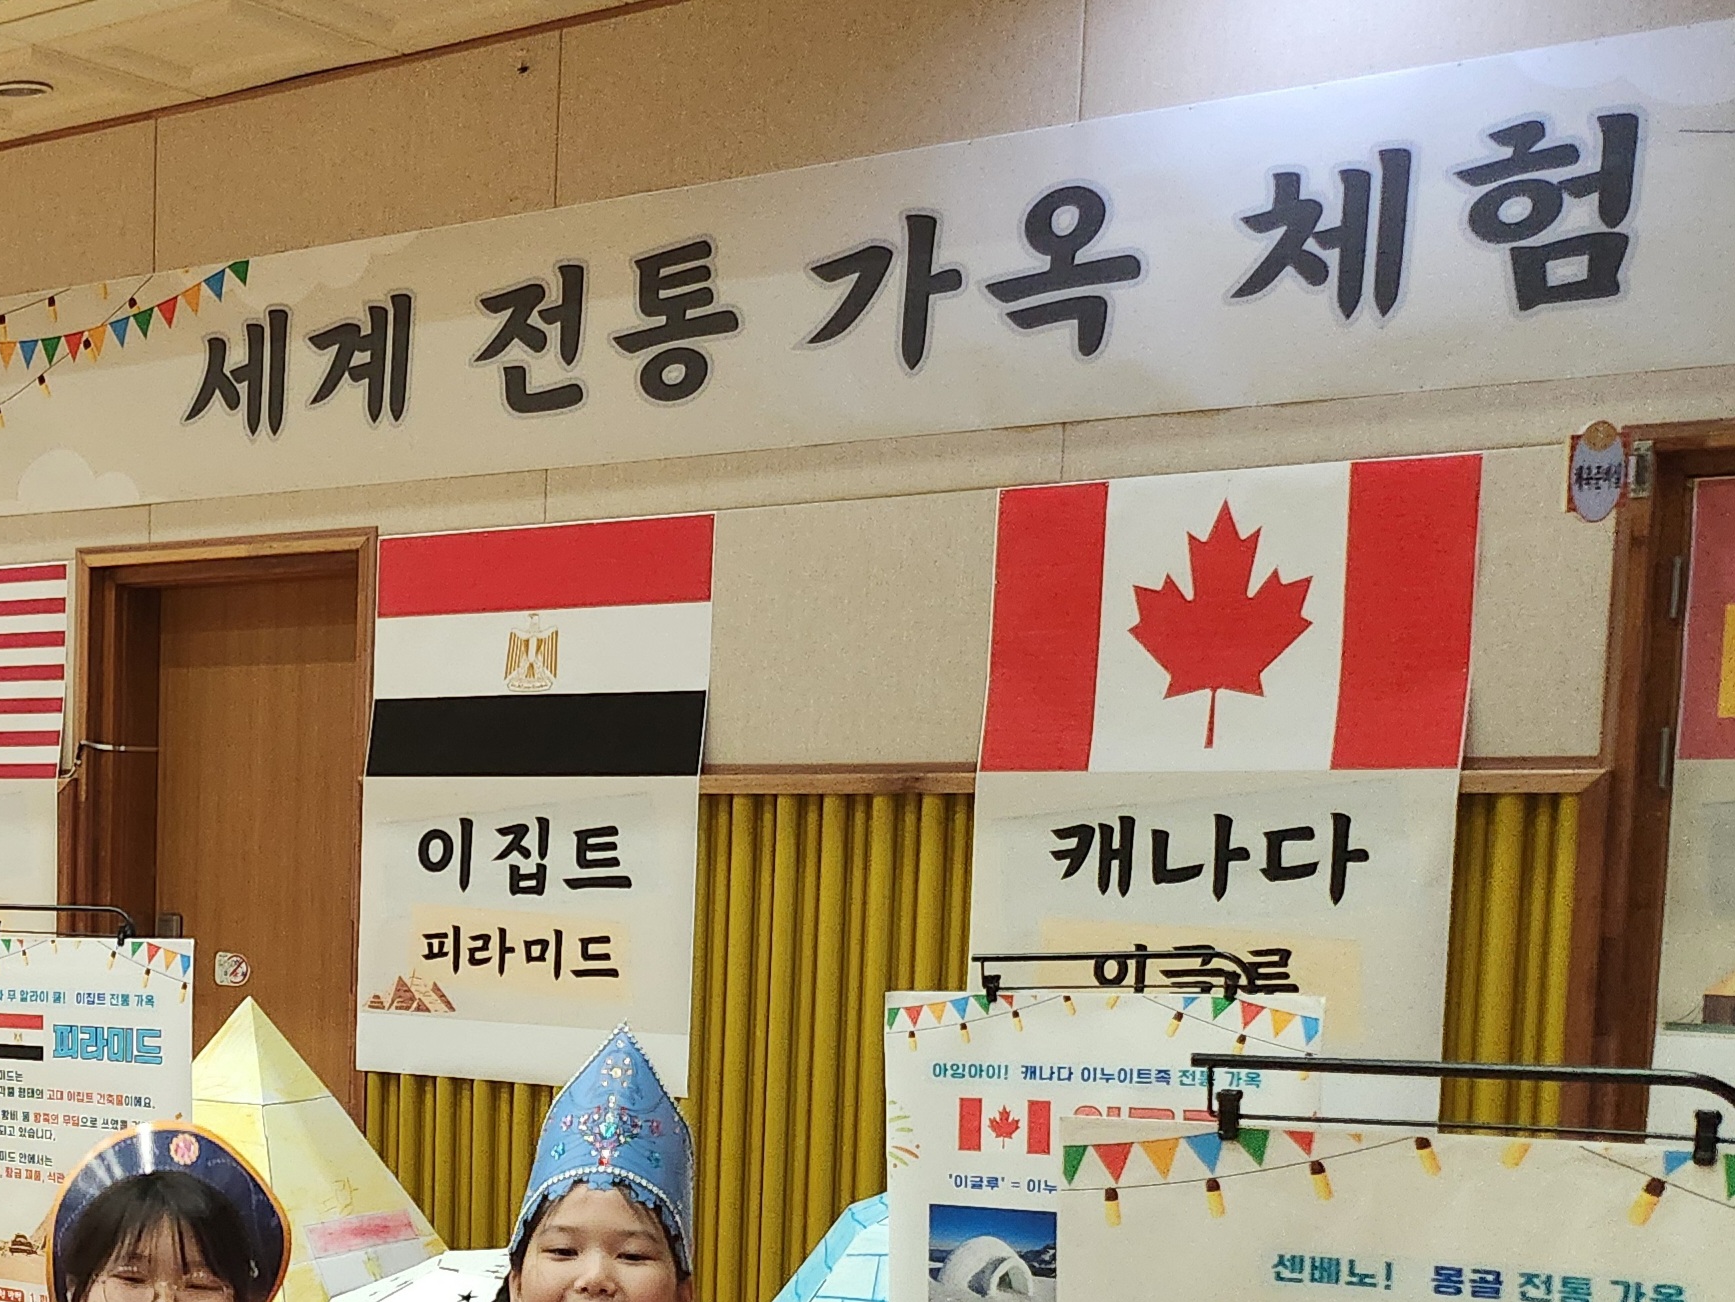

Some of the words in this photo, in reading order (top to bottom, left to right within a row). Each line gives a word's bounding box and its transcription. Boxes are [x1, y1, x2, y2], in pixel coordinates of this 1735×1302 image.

[189, 293, 410, 437] 세계
[478, 234, 742, 415] 전통
[802, 185, 1142, 370] 가옥
[1231, 111, 1641, 321] 체험
[418, 816, 633, 896] 이집트
[1049, 813, 1370, 906] 캐나다
[420, 925, 620, 981] 피라미드
[20, 990, 49, 1003] 알라이
[75, 992, 106, 1006] 이집트
[109, 993, 130, 1007] 전통
[134, 994, 155, 1008] 가옥
[53, 1023, 163, 1065] 피라미드
[933, 1063, 1009, 1081] 아잉아이!
[1021, 1065, 1074, 1083] 캐나다
[1080, 1067, 1171, 1087] 이누이트족
[1178, 1070, 1215, 1088] 전통
[1227, 1070, 1263, 1090] 가옥
[46, 1089, 64, 1101] 고대
[67, 1090, 94, 1104] 이집트
[18, 1126, 56, 1142] 있습니다.
[63, 1114, 98, 1129] 무덤으로
[19, 1152, 54, 1167] 안에서는
[948, 1173, 1006, 1192] '이글루'
[1272, 1253, 1394, 1291] 센베노!
[1431, 1266, 1504, 1301] 몽골
